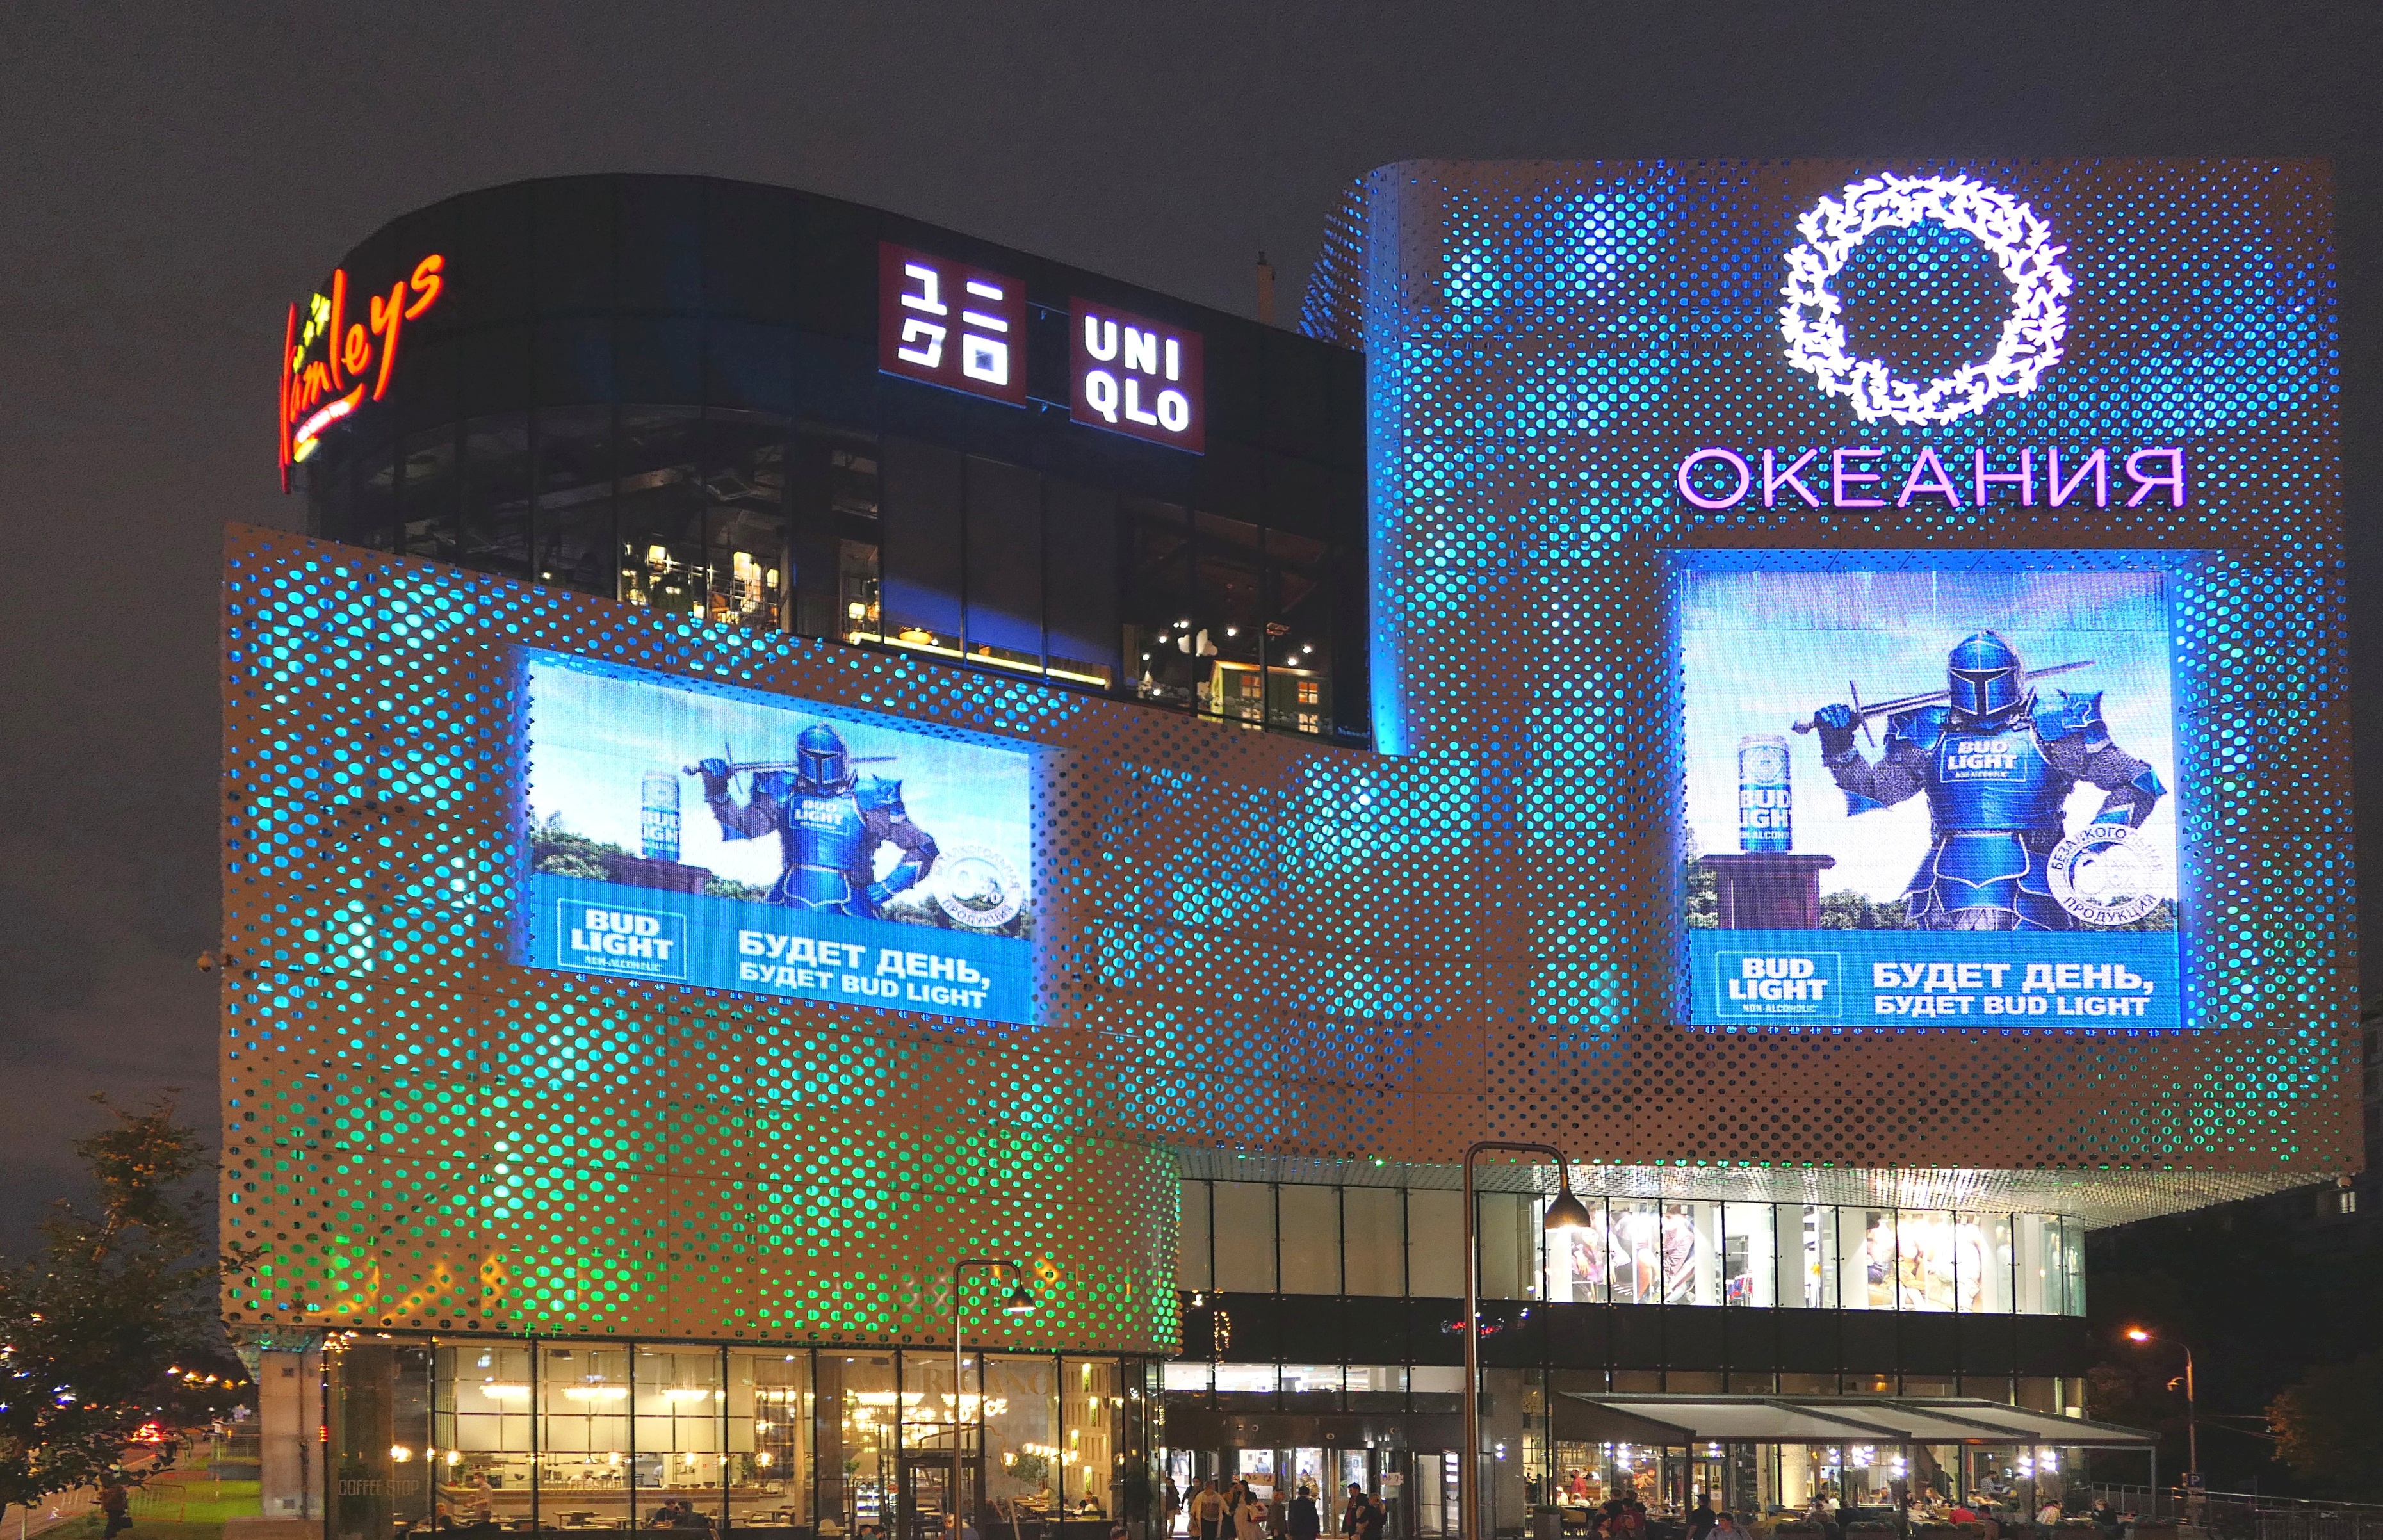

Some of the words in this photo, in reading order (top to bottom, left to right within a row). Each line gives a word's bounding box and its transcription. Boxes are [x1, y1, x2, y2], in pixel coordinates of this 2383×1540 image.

[1084, 315, 1179, 381] UNI
[1085, 369, 1189, 432] QLO
[1677, 447, 2186, 509] ОКЕАНИЯ
[1958, 740, 2008, 754] BUD
[1948, 754, 2019, 770] LIGHT
[1741, 809, 1789, 828] IGH
[2063, 894, 2157, 922] ПРОДУКЦИЯ
[586, 908, 660, 937] BUD
[571, 928, 674, 960] LIGHT
[738, 928, 866, 969] БУДЕТ
[876, 948, 991, 991] ДЕНЬ,
[1742, 957, 1814, 979] BUD
[739, 961, 834, 990] БУДЕТ
[841, 973, 899, 998] BUD
[906, 982, 988, 1009] LIGHT
[1728, 978, 1828, 1000] LIGHT
[1873, 962, 2011, 993] БУДЕТ
[2022, 963, 2154, 995] ДЕНЬ,
[1874, 995, 1975, 1018] БУДЕТ
[1983, 996, 2049, 1016] BUD
[2056, 996, 2151, 1016] LIGHT
[339, 1479, 382, 1496] COFFEE
[386, 1479, 419, 1496] STOP
